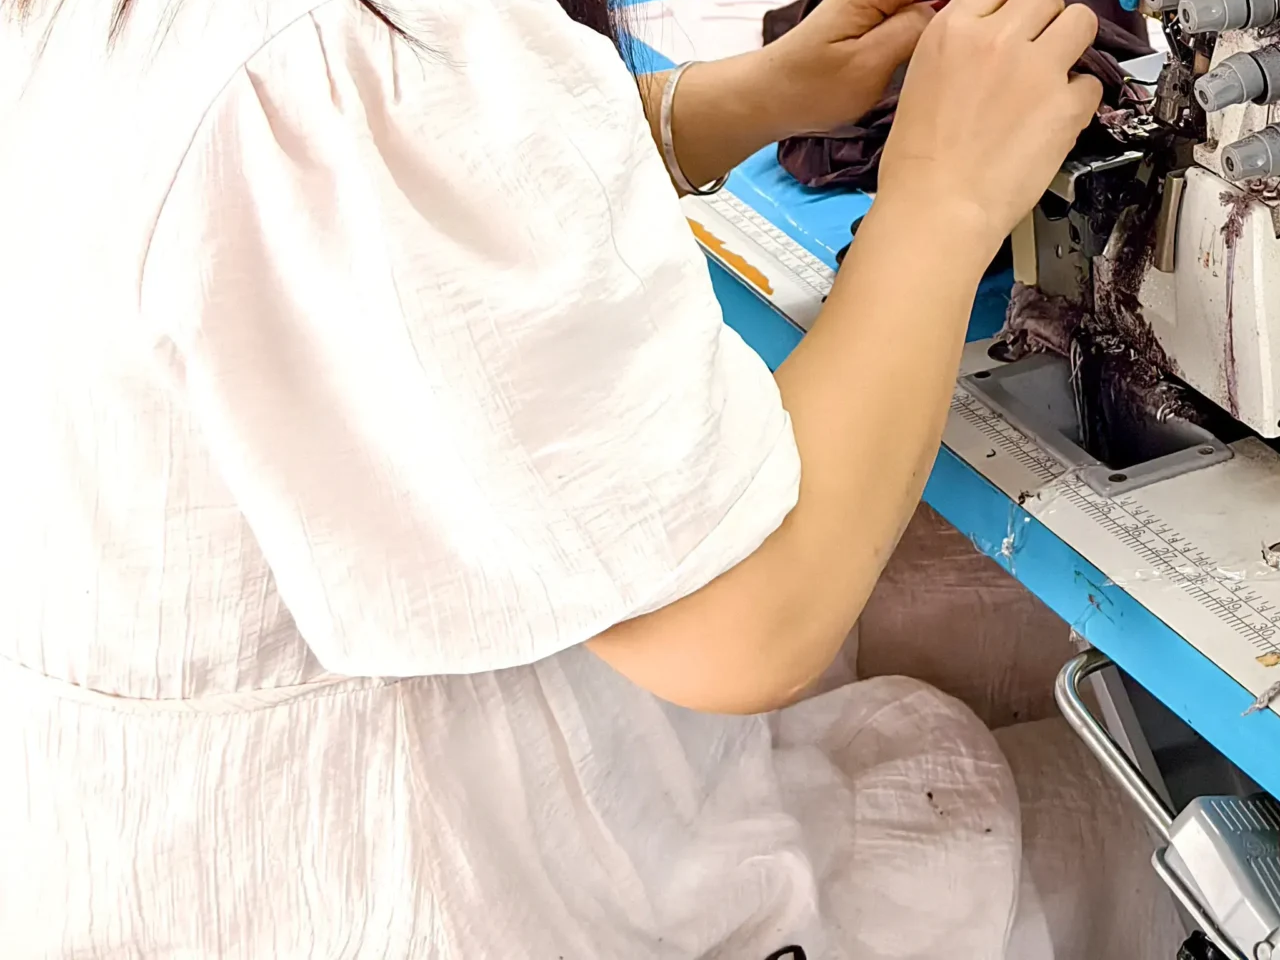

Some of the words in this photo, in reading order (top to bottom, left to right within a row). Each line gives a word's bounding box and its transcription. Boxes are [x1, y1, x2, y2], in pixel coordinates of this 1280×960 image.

[1094, 500, 1115, 514] 25
[1124, 523, 1145, 538] 26
[1155, 547, 1178, 560] 27
[1219, 596, 1242, 614] 29
[1253, 623, 1275, 639] 30
